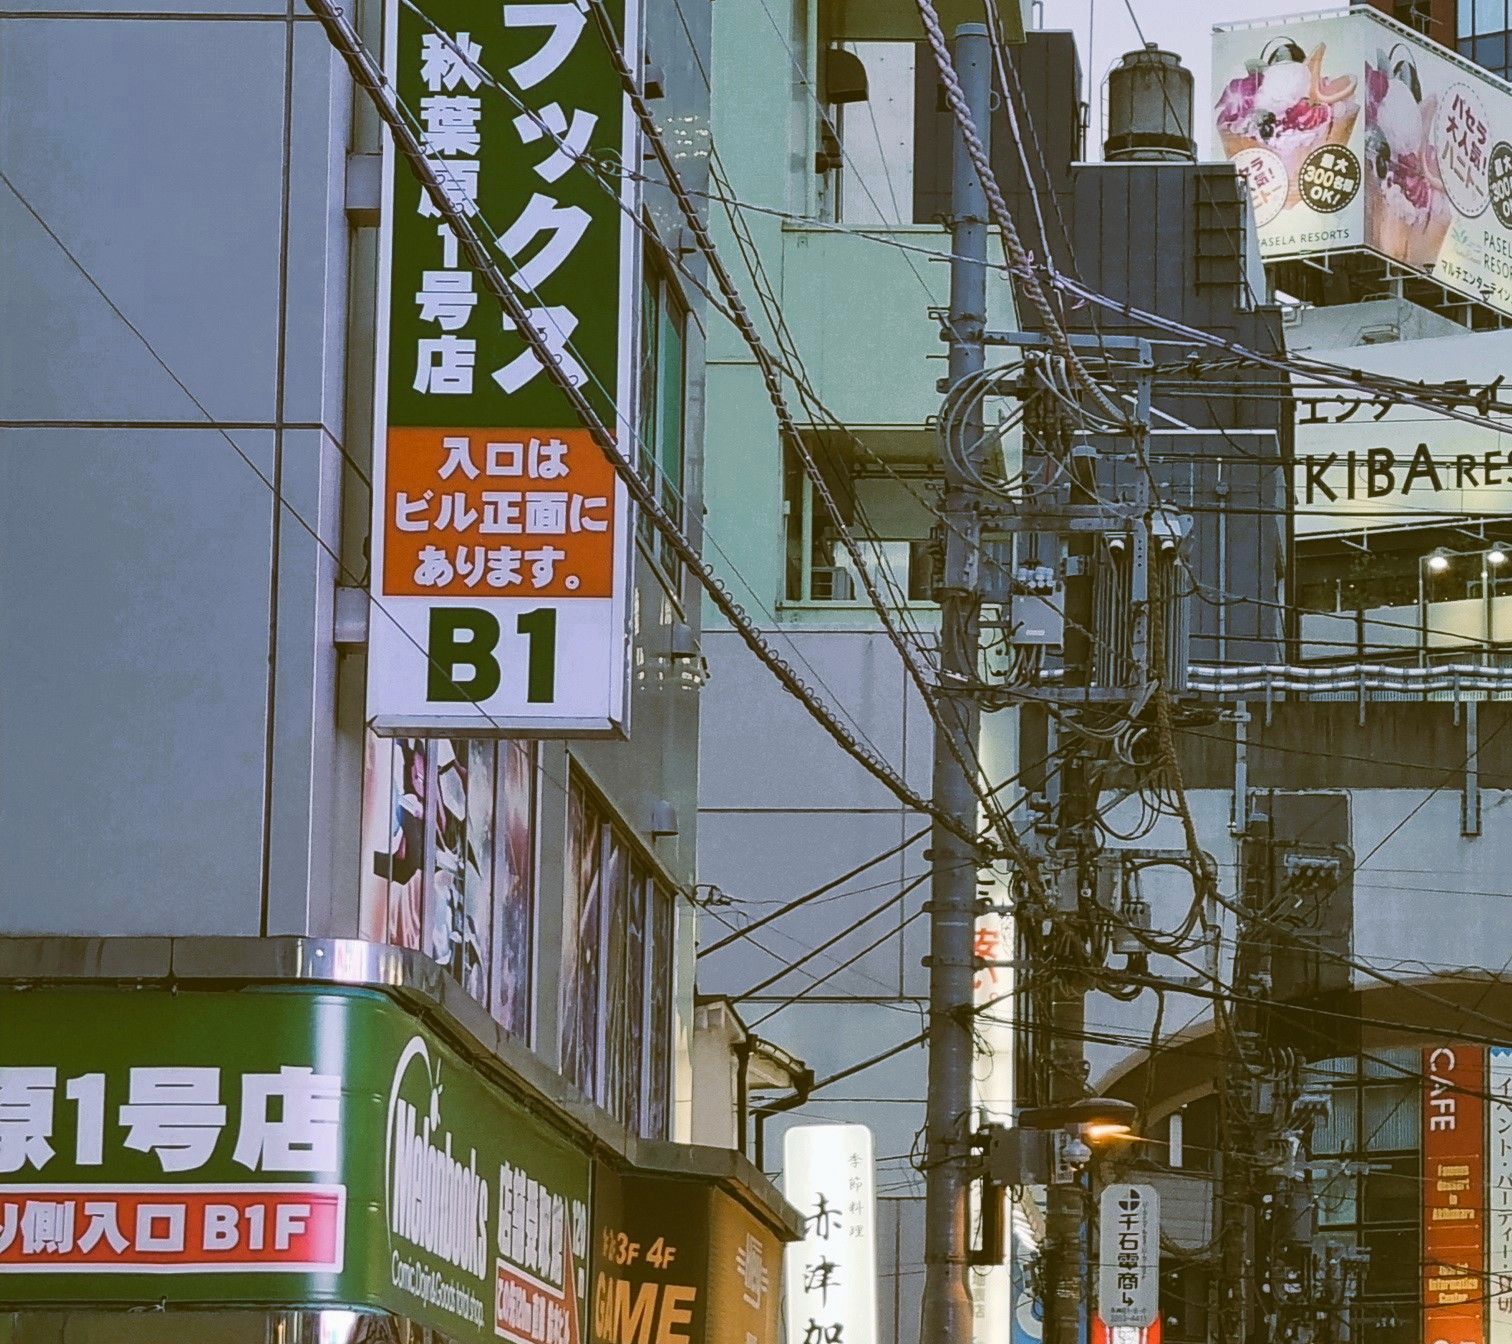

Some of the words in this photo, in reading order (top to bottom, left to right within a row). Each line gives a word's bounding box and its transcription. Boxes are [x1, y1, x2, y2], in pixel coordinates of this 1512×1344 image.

[413, 31, 484, 395] 秋葉原1号店
[1310, 186, 1341, 205] OK!
[1301, 229, 1350, 243] RESORTS
[438, 437, 568, 479] 入口は
[394, 492, 609, 534] ビル正面に
[413, 545, 582, 588] あります。
[425, 607, 558, 704] B1
[1429, 1047, 1456, 1132] CAFE
[847, 1152, 864, 1239] 季節料理
[203, 1204, 312, 1251] B1F
[1117, 1213, 1140, 1290] 千石電商
